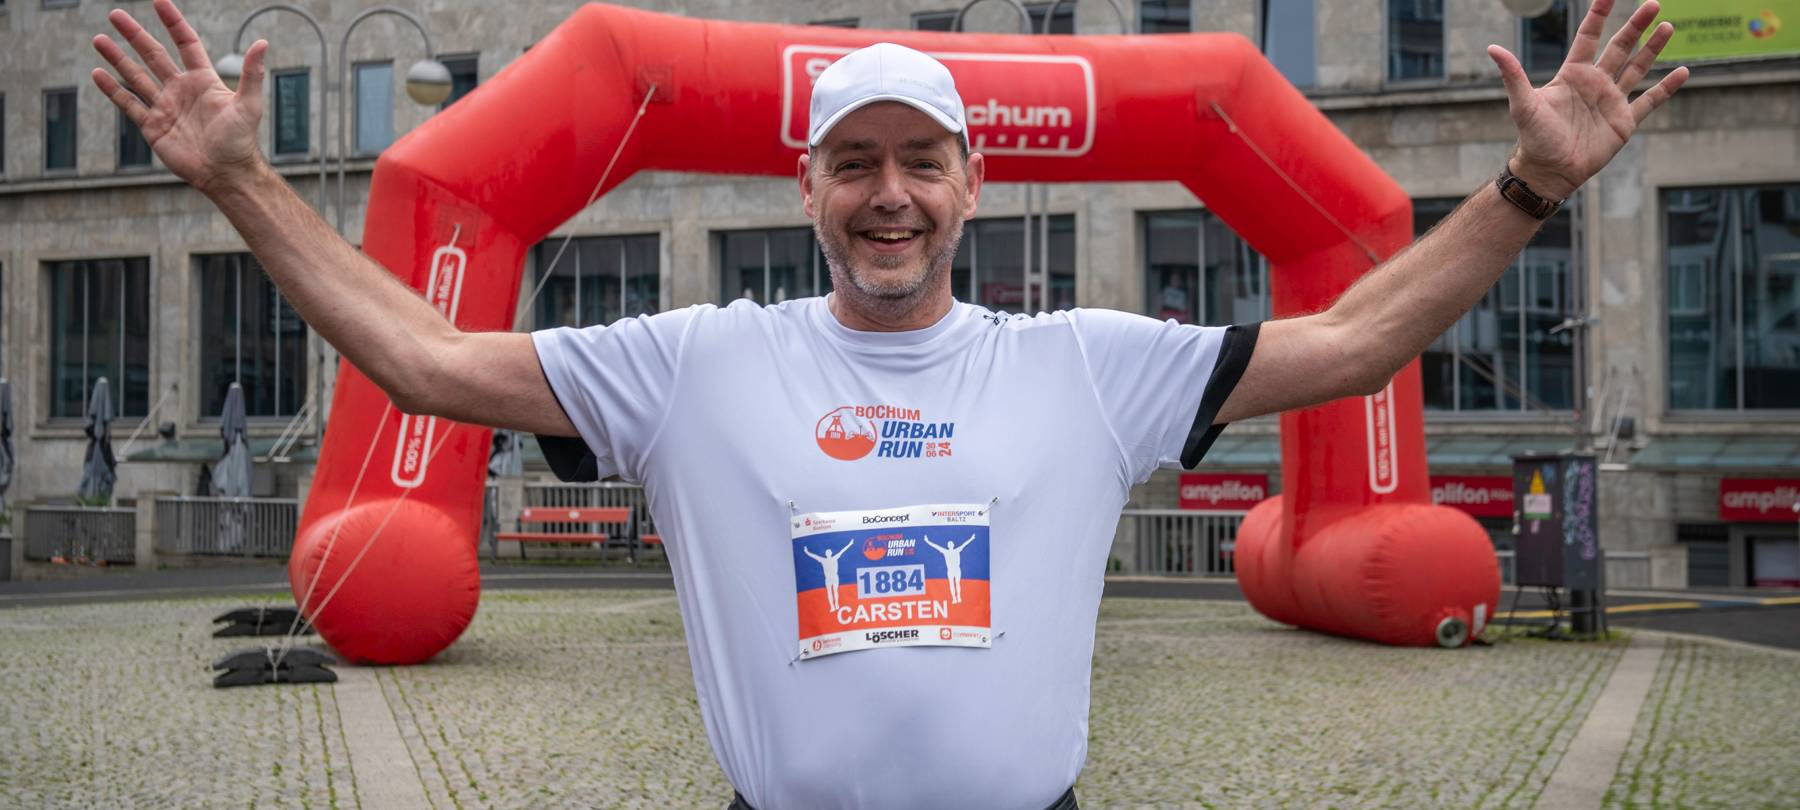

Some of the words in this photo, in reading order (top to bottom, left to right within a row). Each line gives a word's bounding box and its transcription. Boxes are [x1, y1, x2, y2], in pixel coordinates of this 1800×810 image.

[966, 98, 1072, 128] chum
[855, 405, 920, 420] BOCHUM
[881, 421, 954, 439] URBAN
[404, 437, 421, 474] 100%
[877, 440, 923, 458] RUN
[926, 450, 937, 458] 06
[938, 441, 952, 457] 24
[1182, 480, 1264, 505] amplifon
[1431, 482, 1489, 507] plifon
[1723, 487, 1799, 514] amplif
[862, 513, 910, 524] BoConcept
[887, 548, 904, 557] RUN
[888, 539, 916, 548] URBAN
[860, 568, 924, 594] 1884
[837, 600, 948, 625] CARSTEN
[865, 629, 919, 643] LÖSCHER
